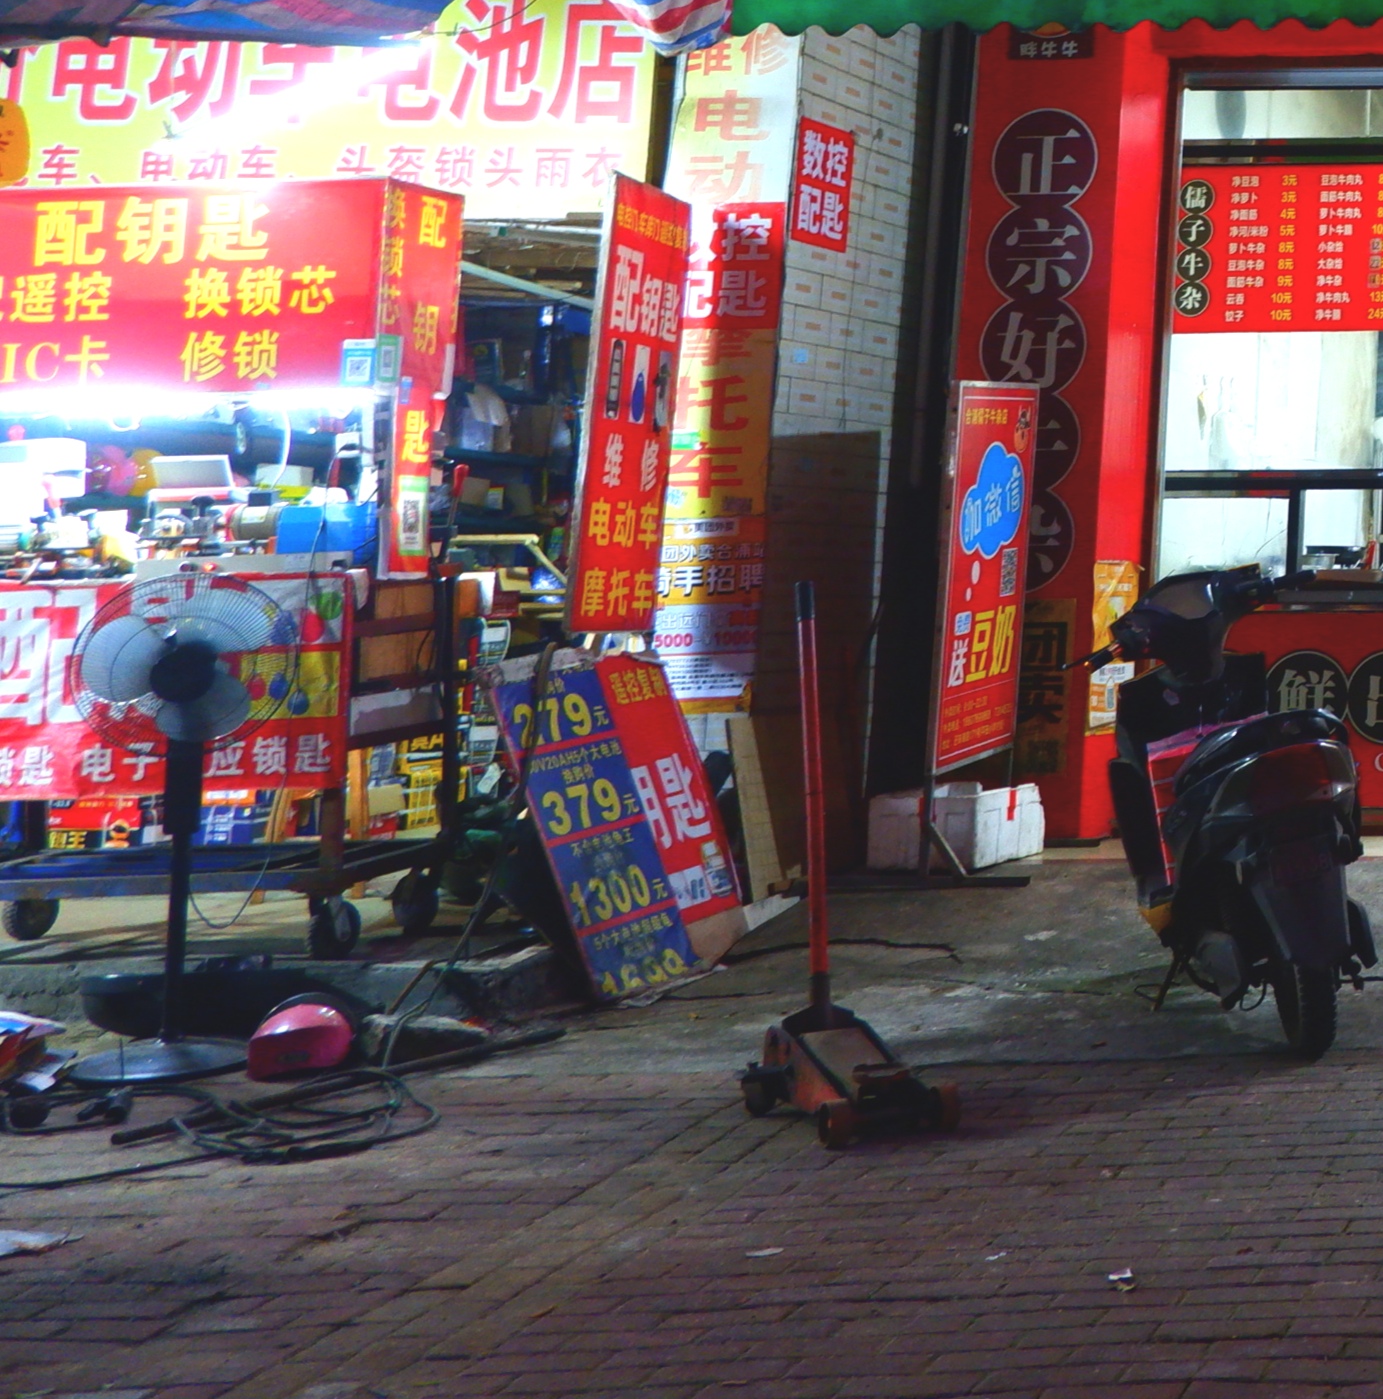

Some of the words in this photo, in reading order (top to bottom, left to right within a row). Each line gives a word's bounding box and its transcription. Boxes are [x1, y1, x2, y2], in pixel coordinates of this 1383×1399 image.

[801, 129, 850, 188] 数控
[1282, 175, 1297, 186] 3元
[1280, 208, 1296, 219] 4元
[1281, 192, 1297, 203] 3元
[34, 194, 270, 267] 配钥匙
[1180, 185, 1207, 310] 儒子牛杂
[1280, 225, 1295, 236] 5元
[0, 271, 112, 324] 遥控
[183, 265, 337, 320] 换锁芯
[610, 244, 681, 343] 配钥匙
[1270, 309, 1291, 321] 10元
[1271, 292, 1292, 303] 10元
[180, 329, 279, 383] 修锁
[602, 432, 660, 494] 维修
[587, 496, 660, 553] 电动车
[964, 464, 1021, 545] 加微信
[580, 566, 657, 619] 摩托车
[80, 731, 331, 784] 电子应锁匙
[541, 778, 641, 837] 379元
